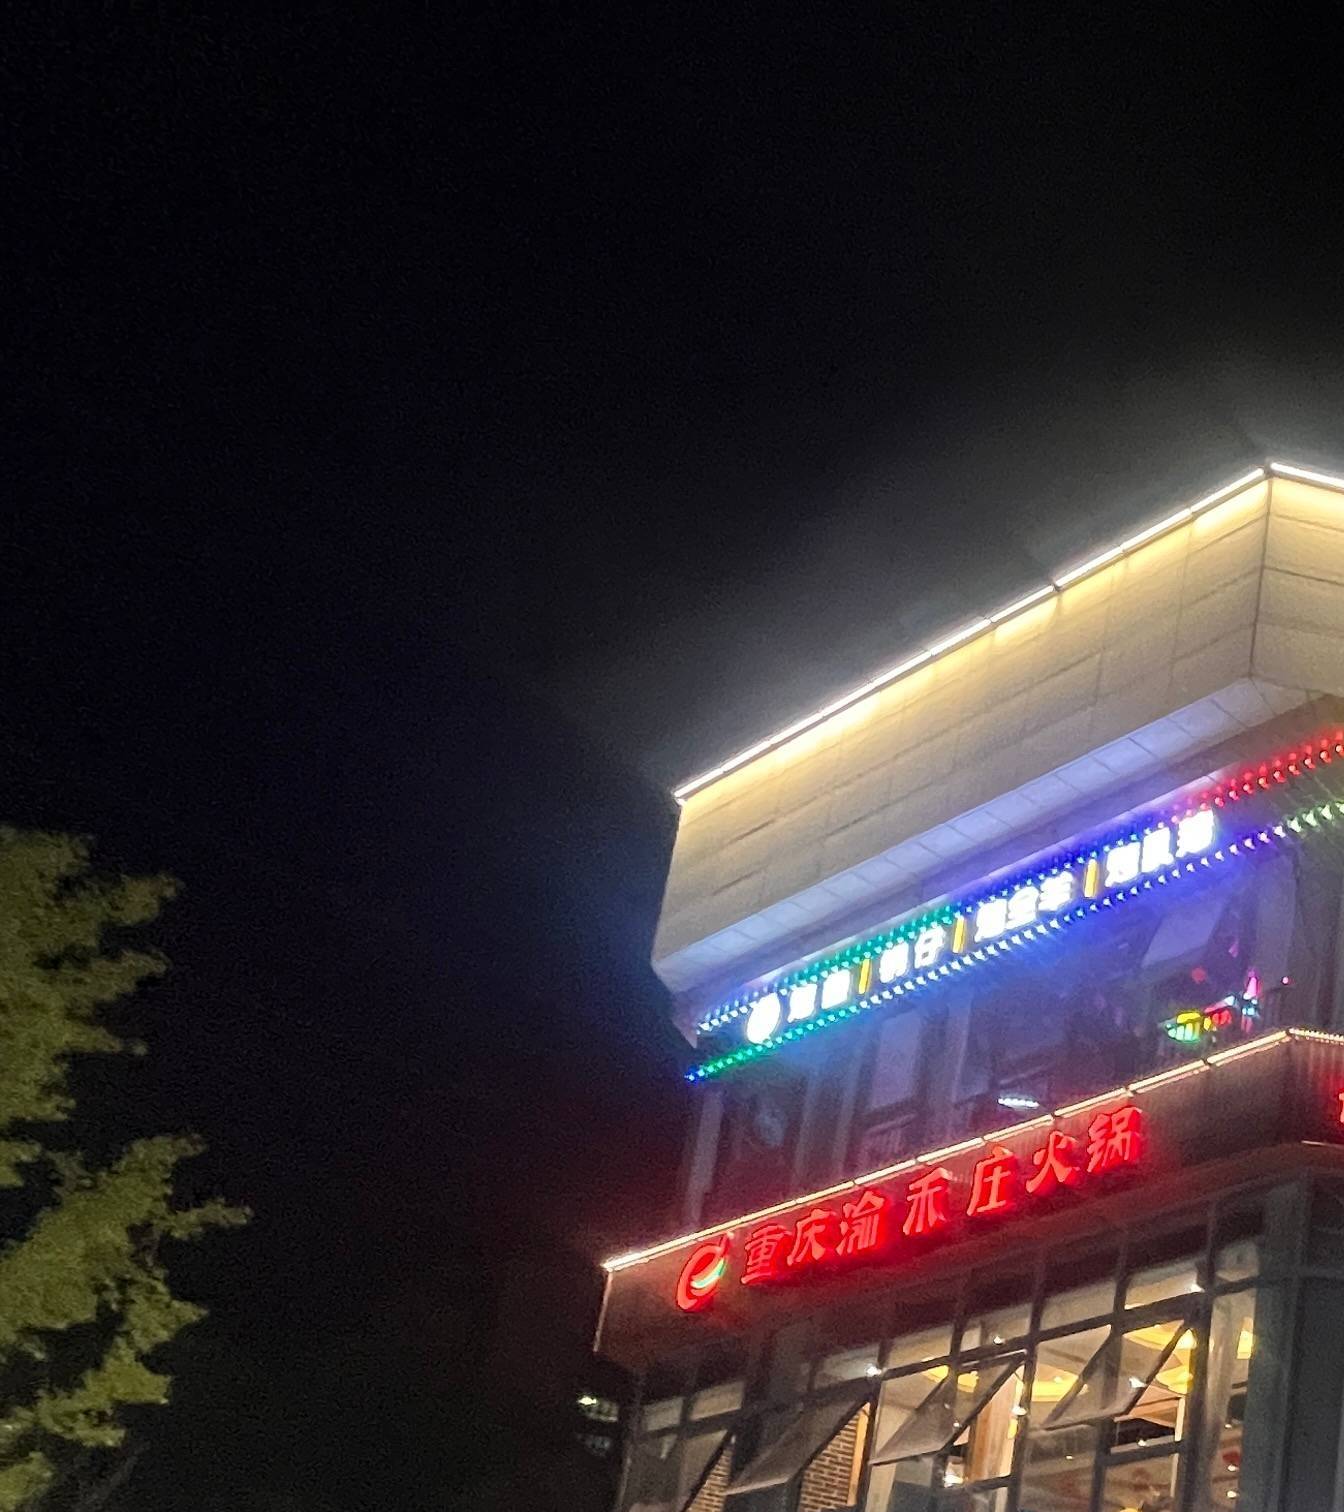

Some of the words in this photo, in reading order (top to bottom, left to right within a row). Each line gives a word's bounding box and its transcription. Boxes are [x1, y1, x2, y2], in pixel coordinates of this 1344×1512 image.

[741, 1105, 1142, 1285] 重庆渝禾庄火锅
